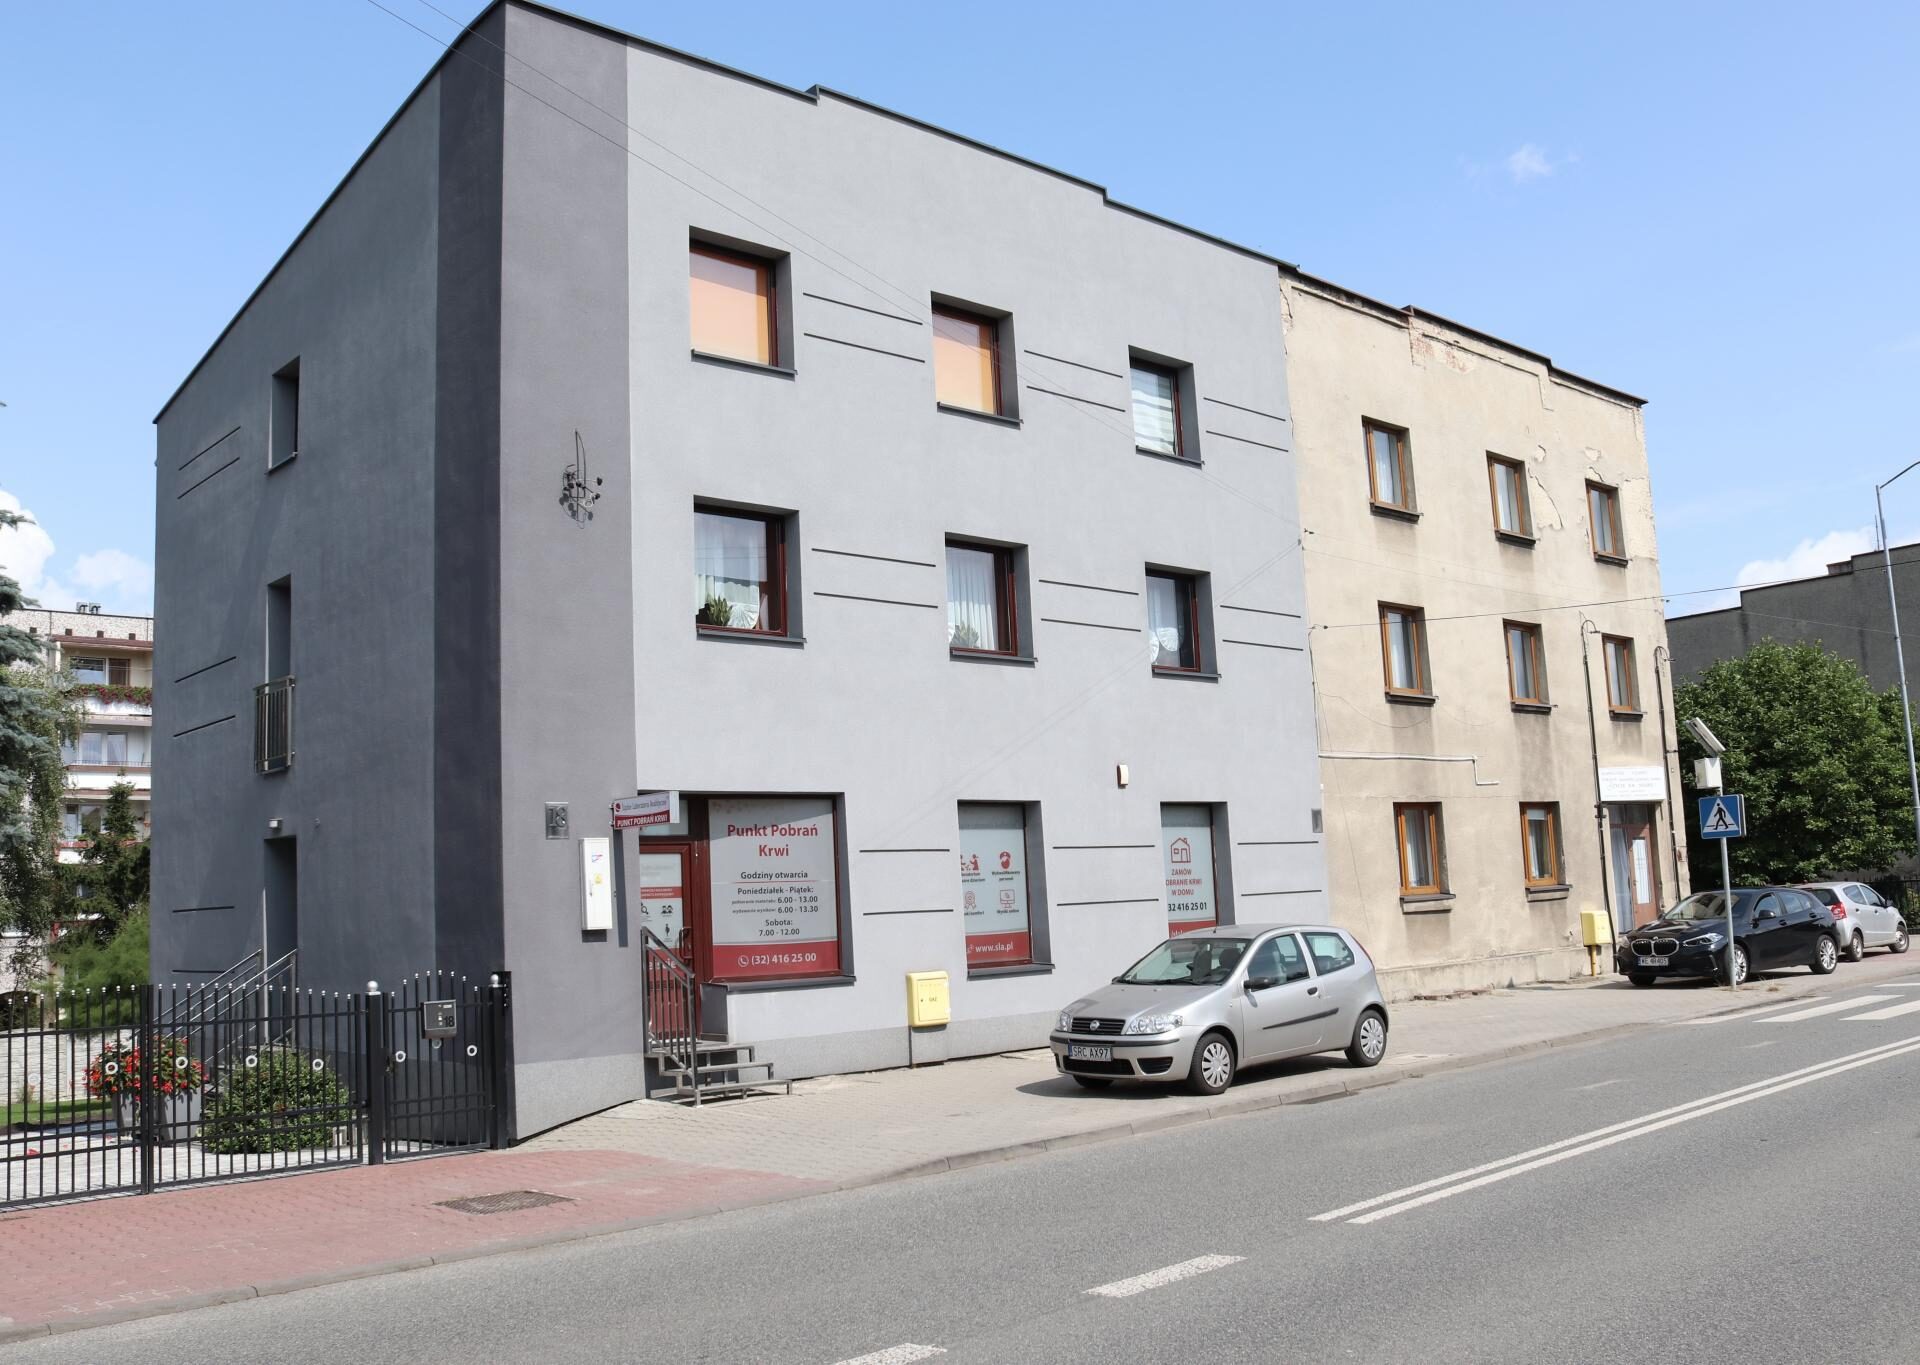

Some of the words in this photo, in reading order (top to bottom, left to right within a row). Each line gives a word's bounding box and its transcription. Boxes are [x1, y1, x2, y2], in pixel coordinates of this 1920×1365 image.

[548, 806, 567, 828] 18
[617, 818, 633, 828] PUNKT
[727, 824, 768, 837] Punkt
[771, 823, 819, 837] Pobrań
[759, 844, 789, 857] Krwi
[740, 871, 773, 881] Godziny
[774, 869, 808, 879] otwarcia
[737, 887, 784, 896] Poniedziałek
[789, 885, 815, 896] Piątek:
[777, 896, 793, 904] 6.00
[798, 895, 818, 903] 13.00
[777, 906, 794, 914] 6.00
[799, 905, 819, 913] 13.30
[1168, 903, 1176, 912] 32
[1177, 902, 1190, 911] 416
[1190, 902, 1199, 911] 25
[1199, 901, 1207, 910] 01
[765, 918, 793, 927] Sobota:
[759, 929, 775, 937] 7.00
[781, 928, 800, 936] 12.00
[975, 941, 1014, 952] www.sla.pl
[751, 953, 770, 967] (32)
[771, 953, 790, 964] 416
[791, 952, 803, 963] 25
[804, 951, 817, 962] 00
[444, 1015, 455, 1028] 18
[1072, 1046, 1088, 1057] SRC
[1089, 1047, 1109, 1059] AX97
